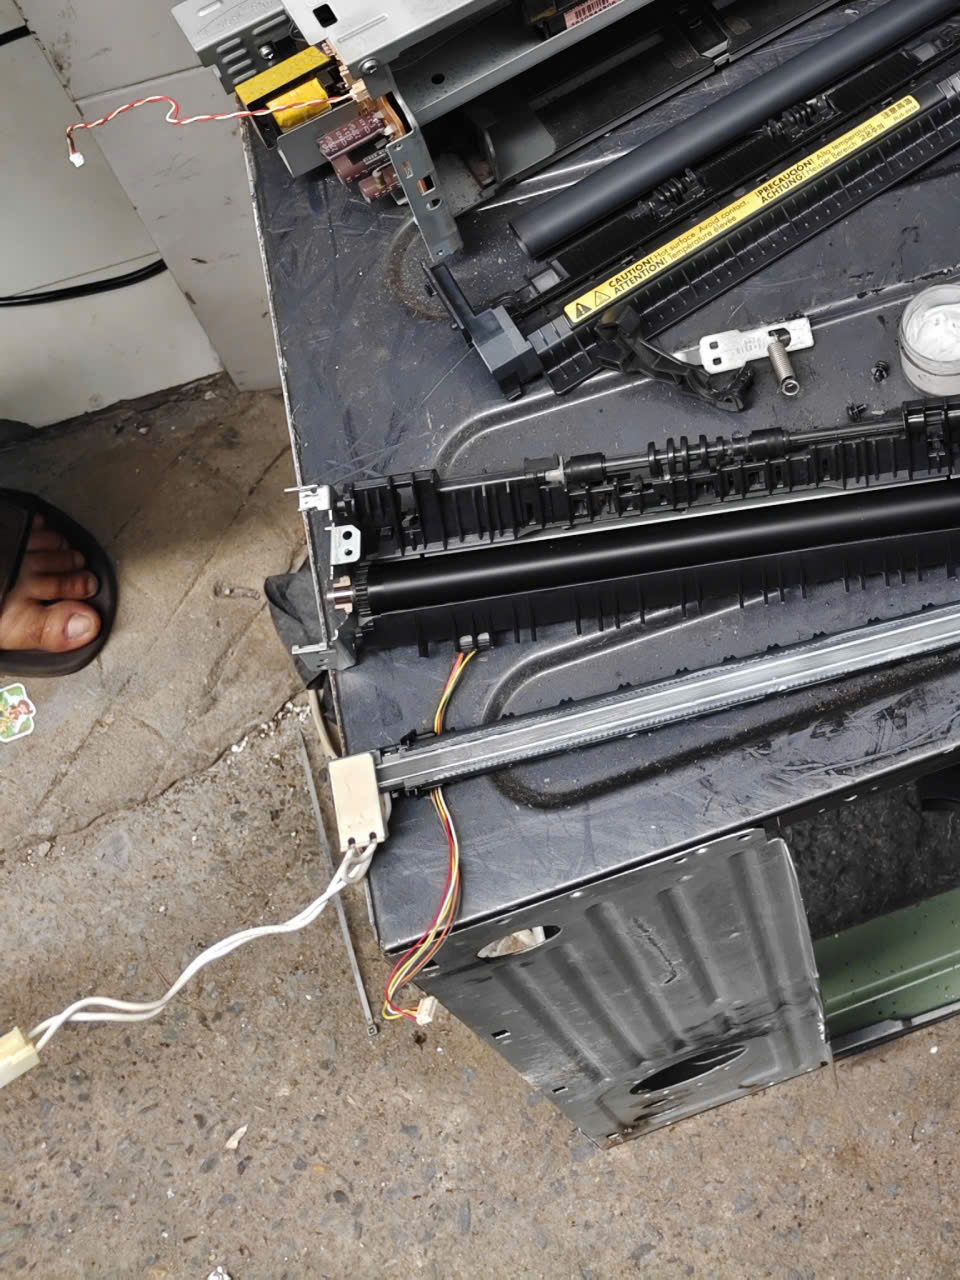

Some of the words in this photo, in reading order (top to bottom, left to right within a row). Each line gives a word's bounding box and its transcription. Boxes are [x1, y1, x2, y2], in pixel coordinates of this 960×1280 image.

[754, 157, 814, 197] ¡PRECAUCIÓN!
[815, 147, 831, 160] Alta
[830, 121, 873, 152] temperatura
[760, 171, 806, 203] ACHTUNG!
[805, 156, 831, 175] Heisser
[831, 139, 857, 158] Bereich
[607, 256, 654, 288] CAUTION!
[653, 246, 669, 260] Hot
[668, 230, 695, 250] surface
[697, 216, 719, 232] Avoid
[613, 257, 667, 294] ATTENTION!
[668, 229, 713, 261] Température
[712, 214, 736, 232] élevée
